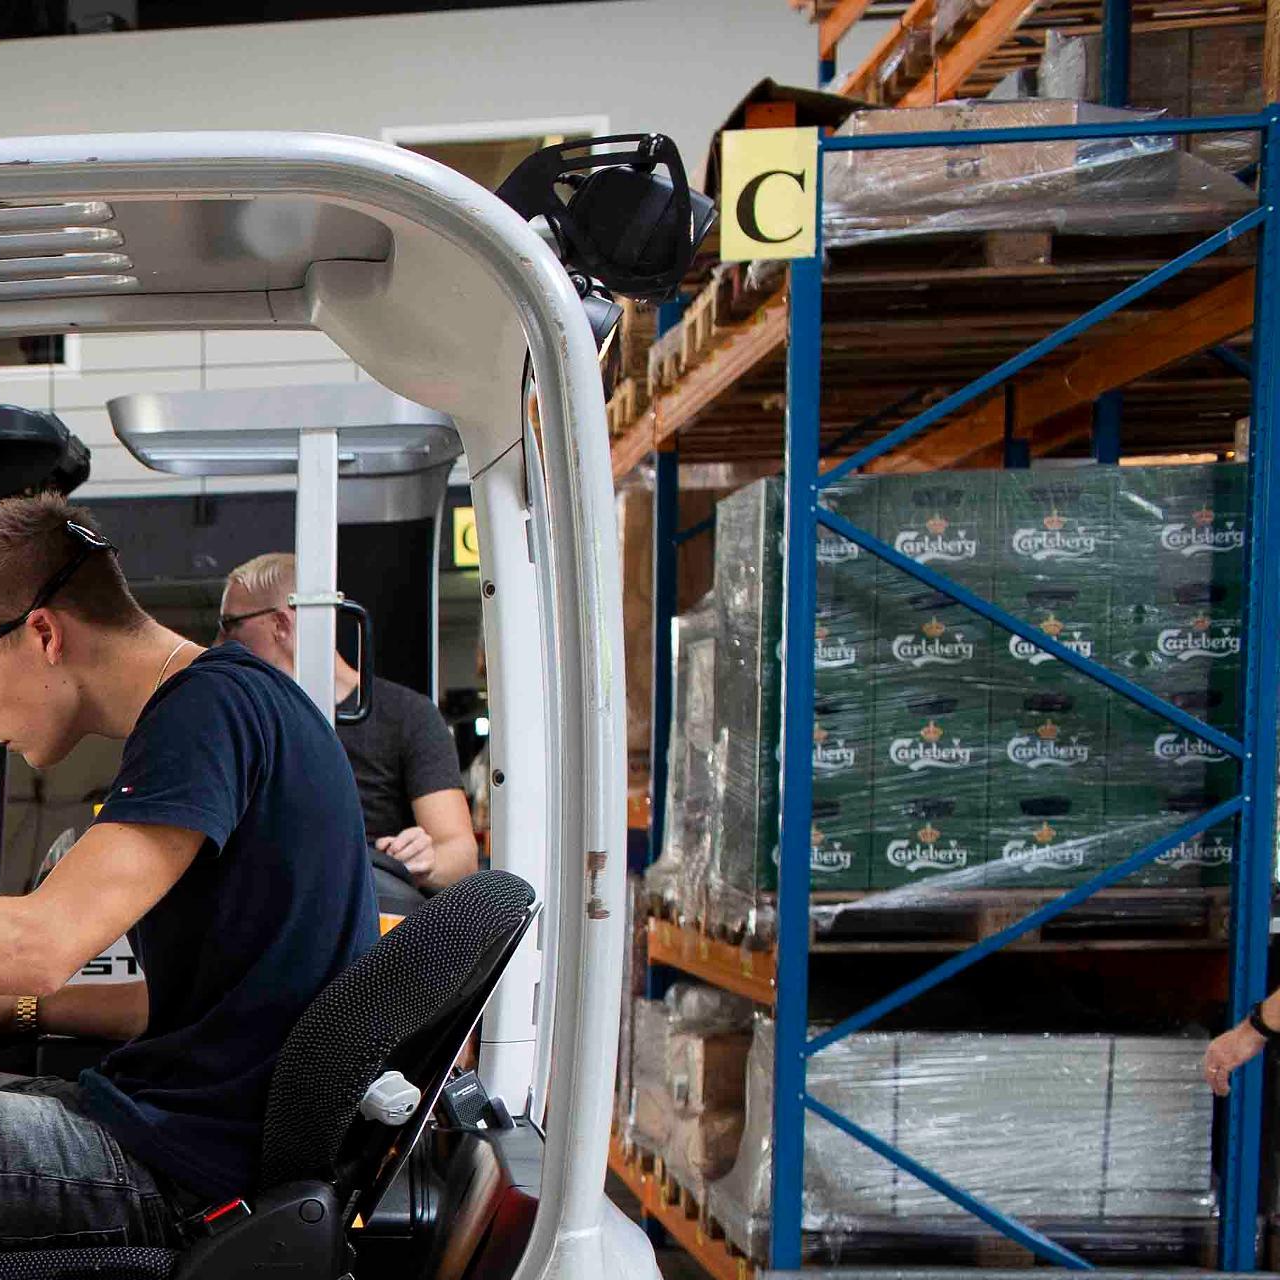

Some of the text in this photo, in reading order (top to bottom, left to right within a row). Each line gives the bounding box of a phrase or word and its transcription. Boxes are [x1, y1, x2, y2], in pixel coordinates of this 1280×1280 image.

[736, 168, 805, 243] C
[895, 530, 976, 563] Carlsberg
[1013, 527, 1095, 560] Carlsberg
[1161, 522, 1244, 557] Carlsberg
[892, 632, 973, 667] Carlsberg
[1158, 628, 1241, 661] Carlsberg
[890, 738, 970, 771] Carlsberg
[1008, 736, 1089, 769] Carlsberg
[887, 840, 967, 872] Carlsberg
[1003, 840, 1084, 873] Carlsberg
